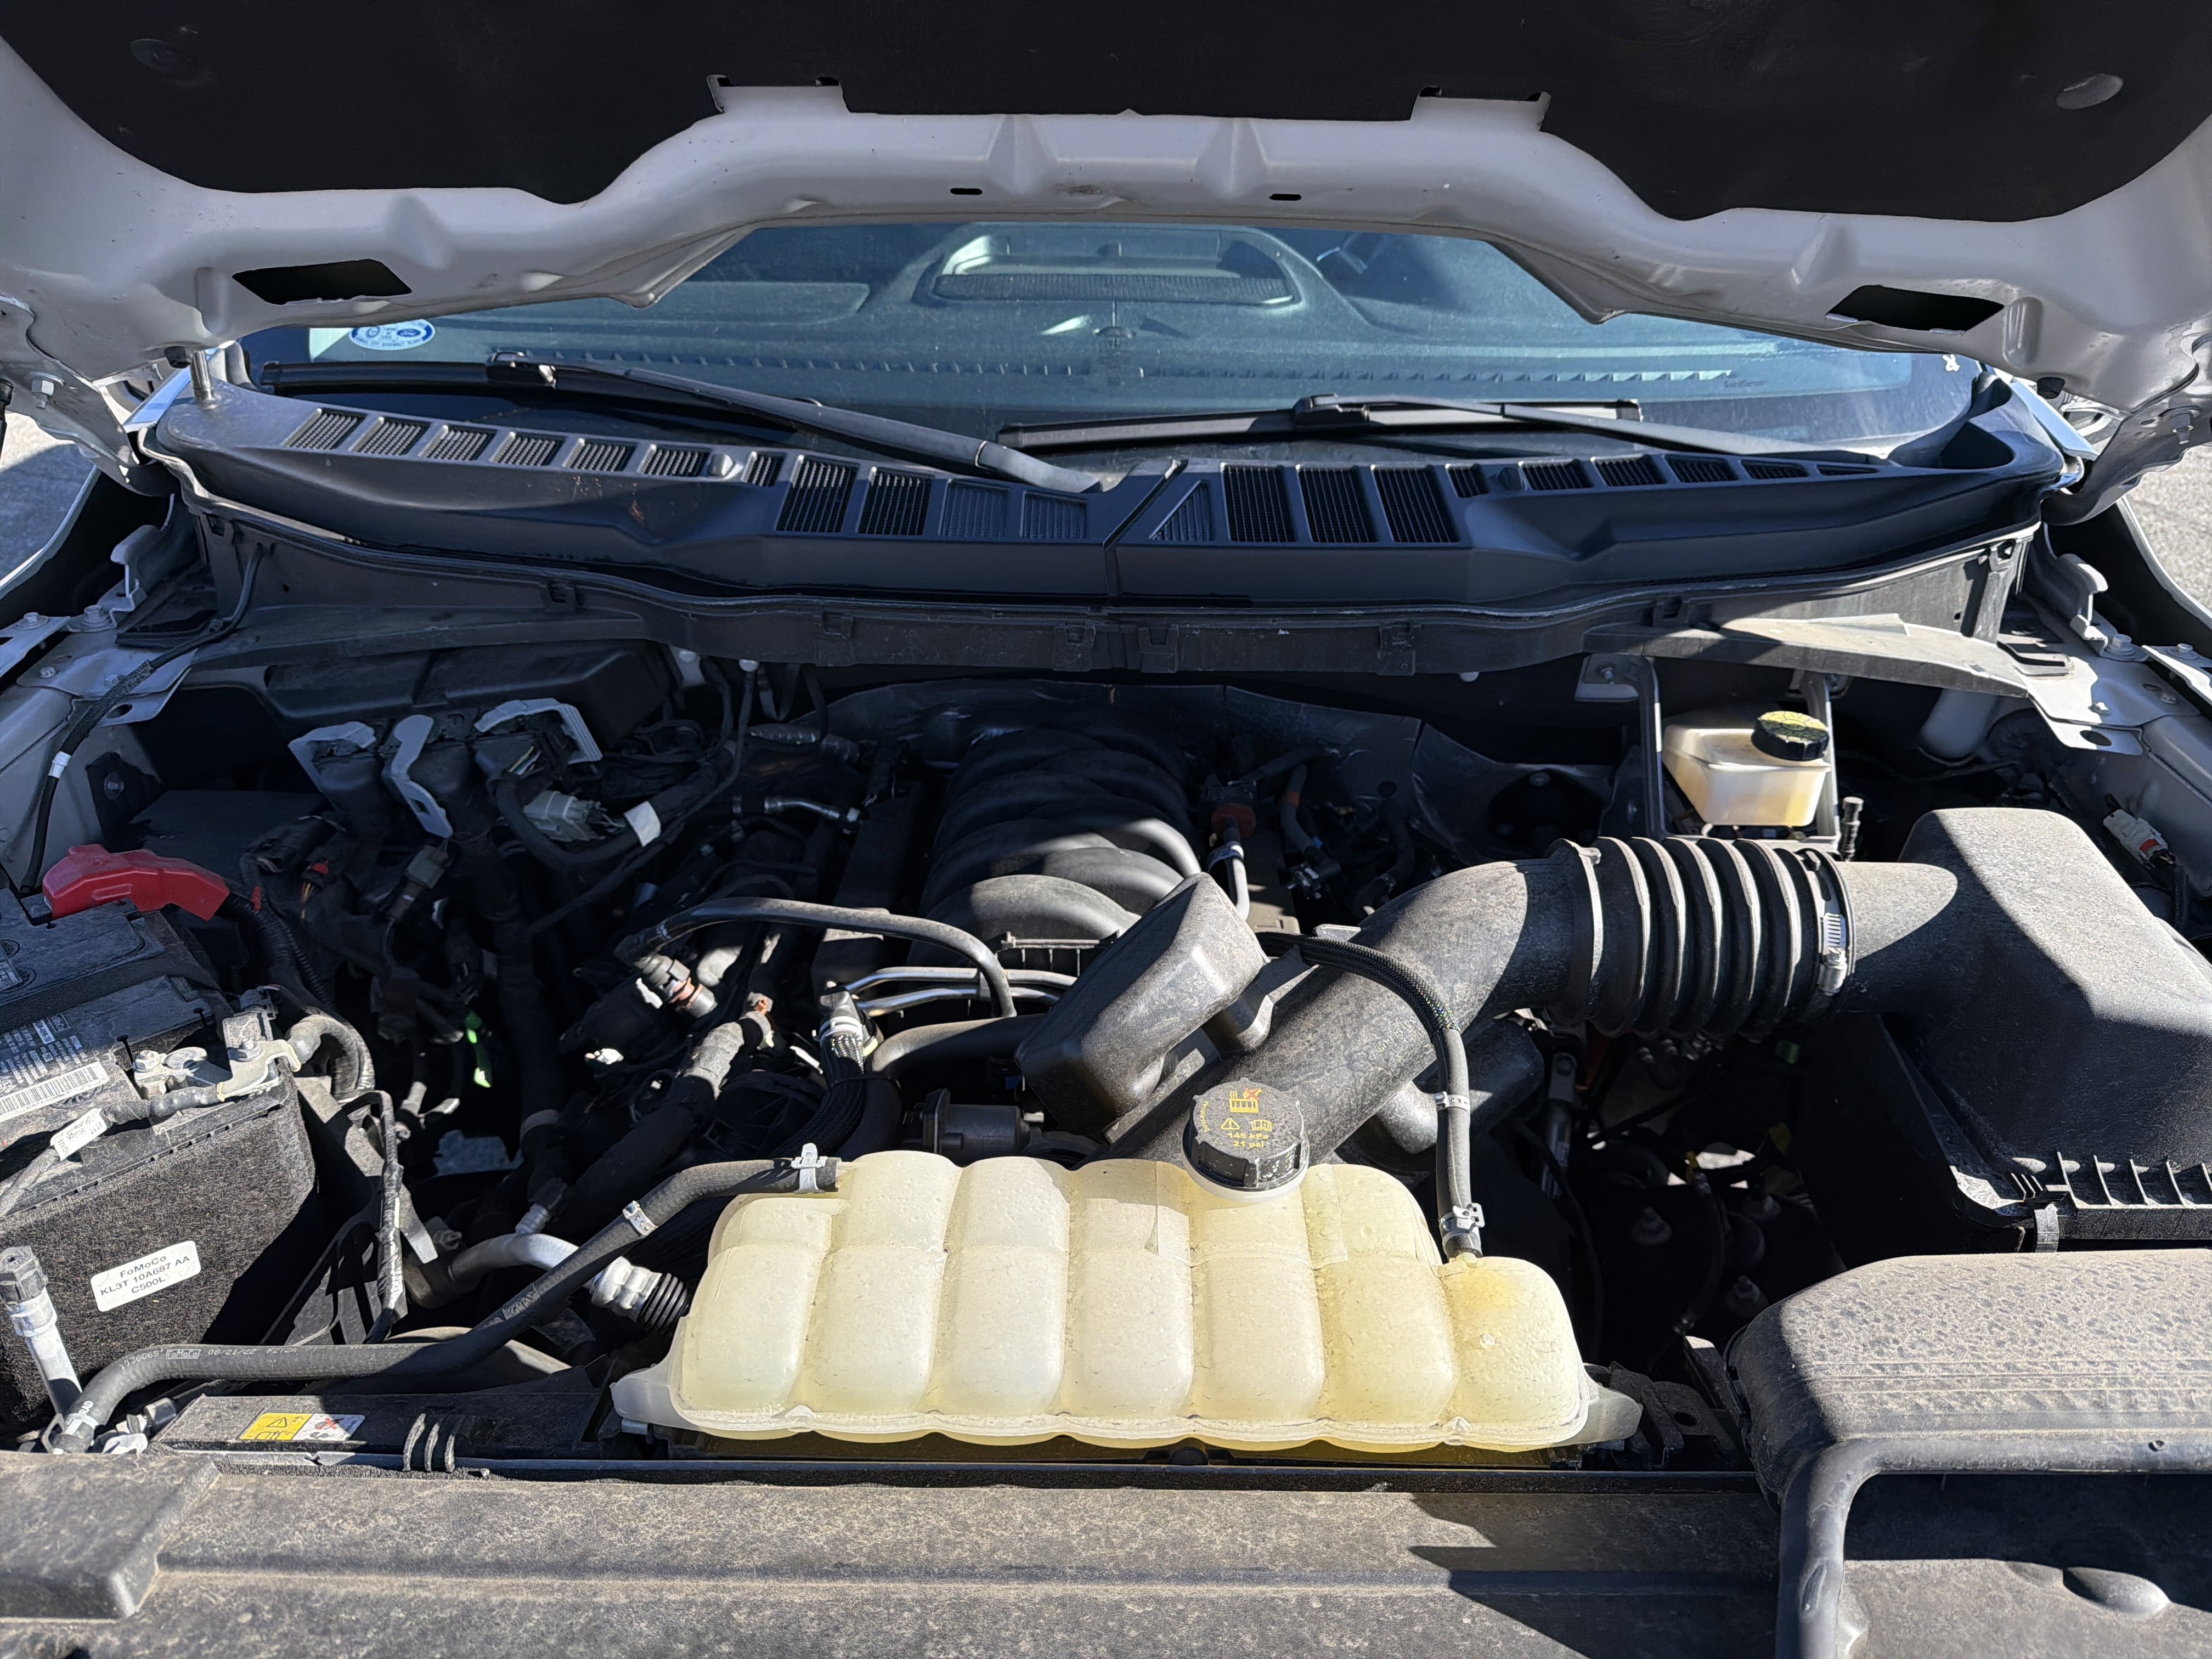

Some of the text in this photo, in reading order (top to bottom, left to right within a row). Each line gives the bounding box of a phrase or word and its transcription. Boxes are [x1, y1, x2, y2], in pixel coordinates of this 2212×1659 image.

[100, 1256, 190, 1296] KL3T 10A687 AA
[120, 1256, 167, 1278] FoMoCo
[131, 1277, 166, 1294] C500L
[167, 1350, 198, 1358] FoMoCo
